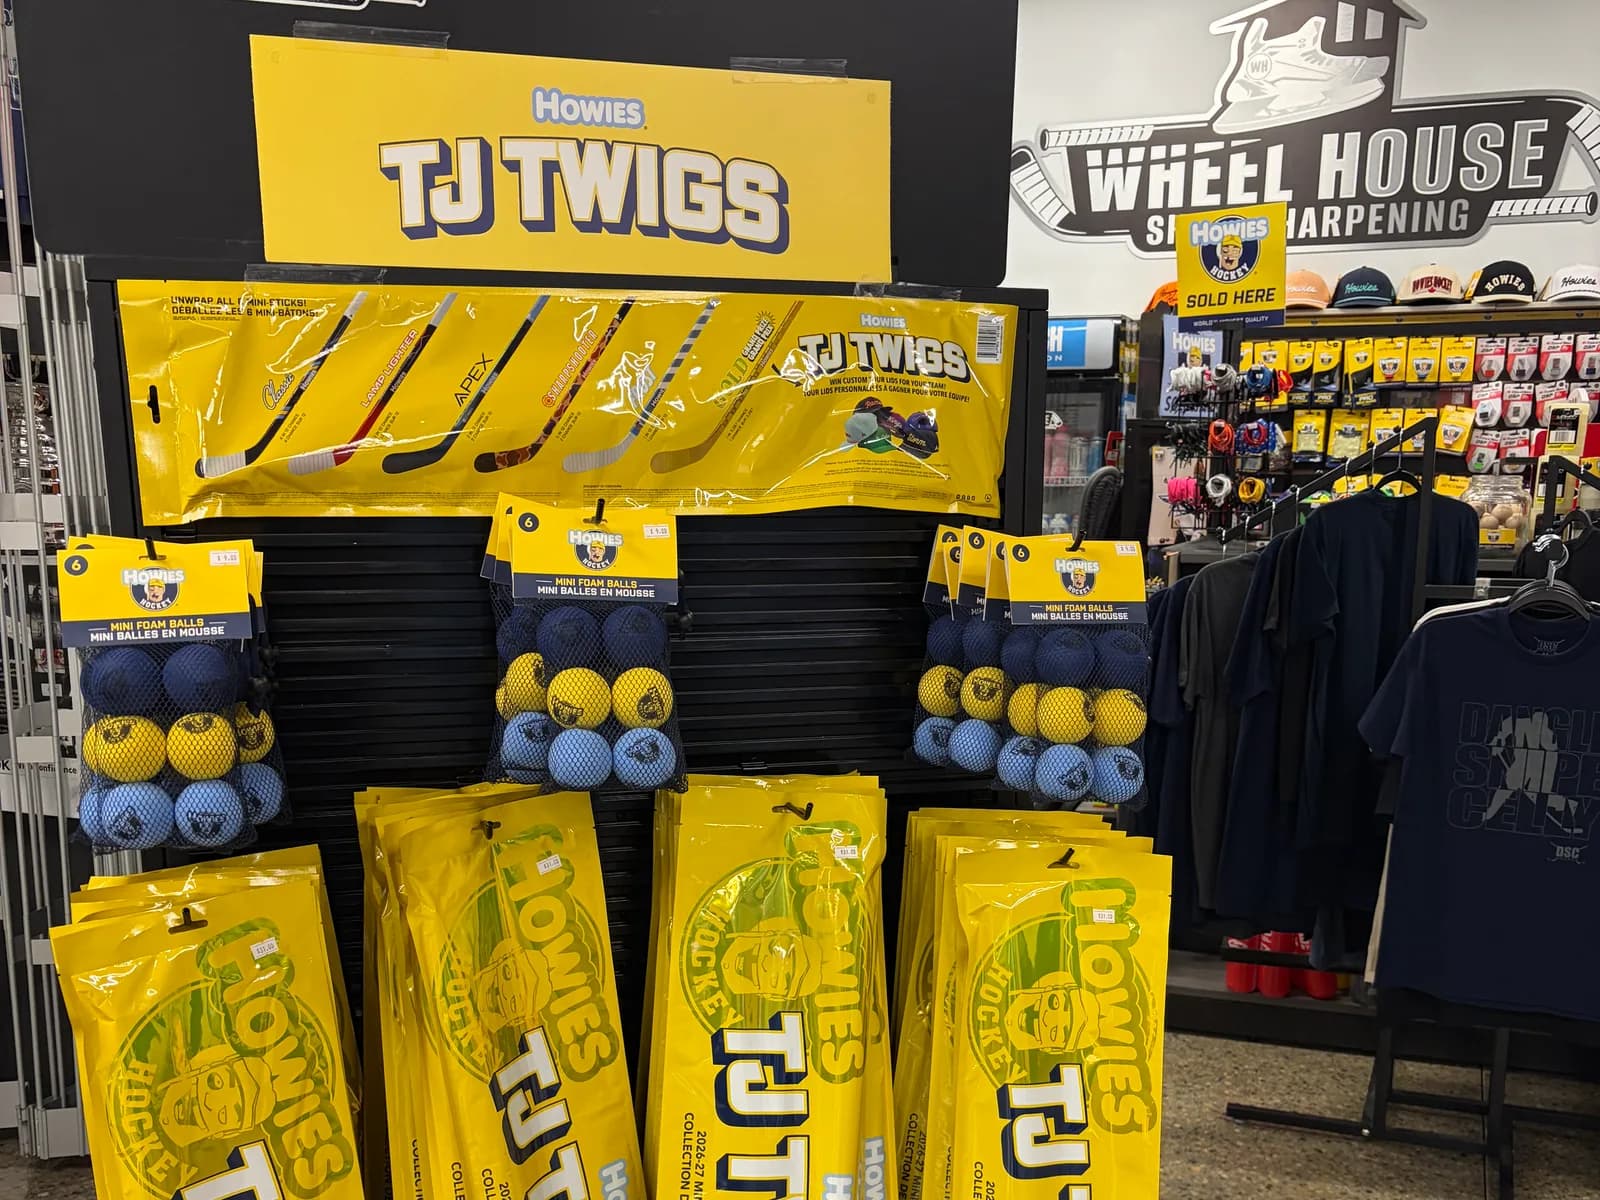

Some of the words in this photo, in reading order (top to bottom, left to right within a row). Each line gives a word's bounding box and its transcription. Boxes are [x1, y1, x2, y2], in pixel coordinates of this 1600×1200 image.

[1250, 59, 1269, 73] WH
[534, 87, 644, 128] HOWIES
[1087, 139, 1294, 212] WHEEL
[1318, 118, 1550, 199] HOUSE
[379, 136, 495, 240] TJ
[499, 136, 790, 255] TWIGS
[1286, 199, 1470, 239] HARPENING
[1190, 217, 1269, 247] HOWIES
[1210, 262, 1250, 281] HOCKEY
[1484, 273, 1527, 293] HOWIES
[171, 295, 214, 305] UNWRAP
[216, 296, 235, 305] ALL
[1186, 291, 1229, 308] SOLD
[1233, 287, 1277, 305] HERE
[860, 313, 906, 329] HOWIES
[549, 329, 599, 401] SHARPSHOOTER
[797, 332, 848, 375] TJ
[848, 331, 971, 384] TWIGS
[360, 375, 386, 409] LAMP
[384, 329, 418, 376] LIGHTER
[454, 352, 495, 408] APEX
[829, 378, 842, 386] WIN
[842, 376, 868, 386] CUSTOM
[899, 377, 910, 386] FOR
[262, 374, 296, 410] Classic
[820, 386, 834, 395] LIDS
[929, 389, 948, 399] VOTRE
[524, 516, 533, 528] 6
[568, 529, 624, 546] HOWIES
[973, 535, 981, 546] 6
[1016, 547, 1025, 557] 6
[70, 559, 82, 571] 6
[582, 558, 611, 570] HOCKEY
[1055, 558, 1100, 574] HOWIES
[122, 568, 185, 587] HOWIES
[555, 577, 576, 586] MINI
[578, 578, 605, 587] FOAM
[607, 579, 638, 589] BALLS
[537, 586, 558, 595] MINI
[561, 587, 598, 596] BALLES
[600, 588, 613, 596] EN
[615, 589, 655, 598] MOUSSE
[1066, 584, 1090, 596] HOCKEY
[139, 597, 173, 610] HOCKEY
[1045, 604, 1062, 612] MINI
[1064, 604, 1087, 612] FOAM
[1088, 603, 1113, 612] BALLS
[110, 622, 133, 631] MINI
[136, 620, 166, 630] FOAM
[169, 618, 204, 628] BALLS
[1050, 612, 1081, 621] BALLES
[1083, 612, 1095, 620] EN
[1095, 612, 1129, 620] MOUSSE
[90, 632, 114, 642] MINI
[117, 630, 159, 641] BALLES
[162, 628, 176, 639] EN
[179, 626, 225, 637] MOUSSE
[1555, 846, 1580, 860] DSC
[491, 824, 619, 1082] HOWIES
[784, 821, 864, 1084] HOWIES
[1061, 878, 1157, 1134] HOWIES
[976, 960, 1028, 1082] HOCKEY
[198, 919, 352, 1198] HOWIES
[711, 1011, 810, 1128] TJ
[488, 1024, 573, 1165] TJ
[119, 1061, 200, 1183] HOCKEY
[996, 1063, 1092, 1180] TJ
[679, 1112, 694, 1190] COLLECTION
[694, 1130, 707, 1177] 2026-27
[900, 1112, 919, 1181] COLLECTION
